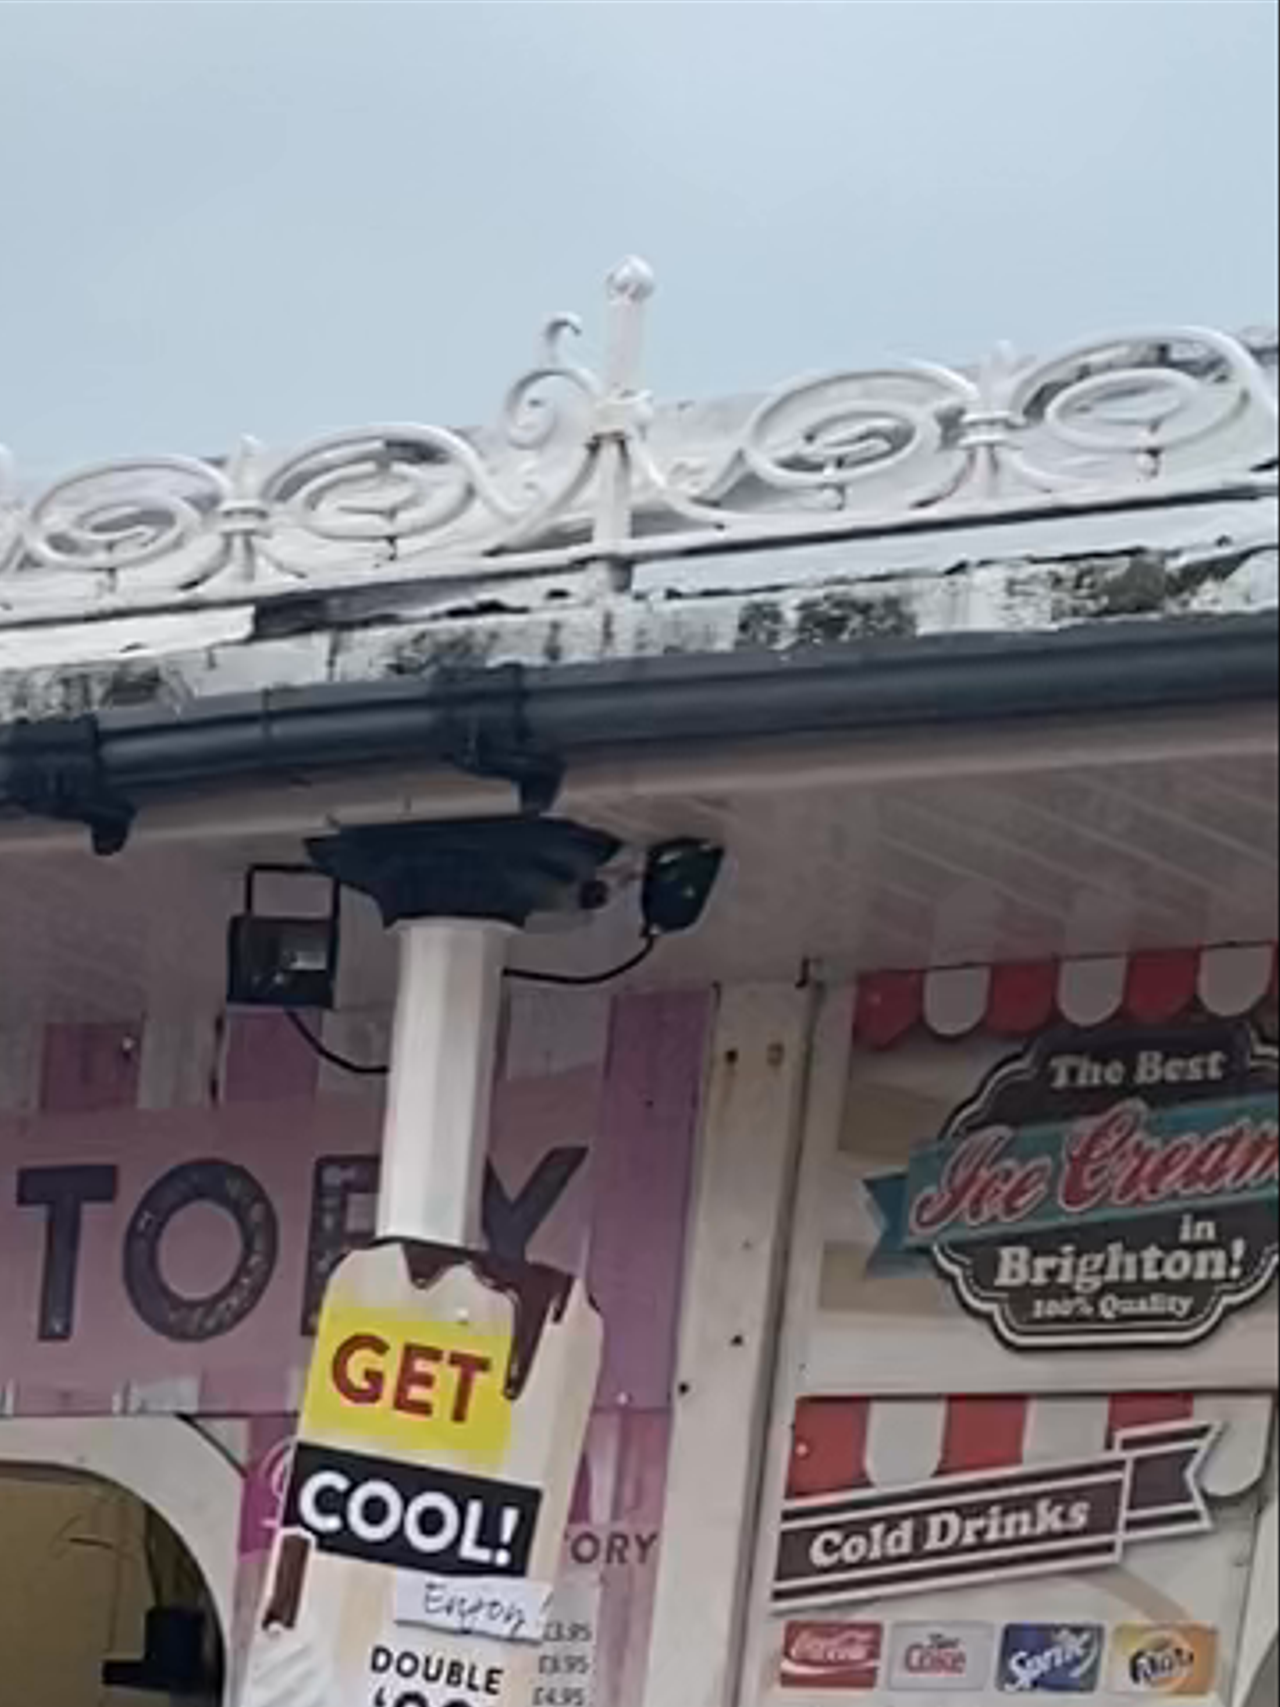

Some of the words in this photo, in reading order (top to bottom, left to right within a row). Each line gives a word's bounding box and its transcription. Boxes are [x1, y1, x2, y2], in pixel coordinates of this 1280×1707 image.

[1050, 1057, 1125, 1088] The
[1133, 1050, 1227, 1083] Best
[909, 1123, 1054, 1236] Ice
[1178, 1213, 1216, 1241] in
[994, 1238, 1246, 1293] Brighton!
[1098, 1292, 1194, 1320] Quality
[331, 1333, 493, 1423] GET
[298, 1470, 520, 1566] COOL!
[808, 1522, 913, 1568] Cold
[923, 1498, 1090, 1550] Drinks
[370, 1645, 504, 1695] DOUBLE
